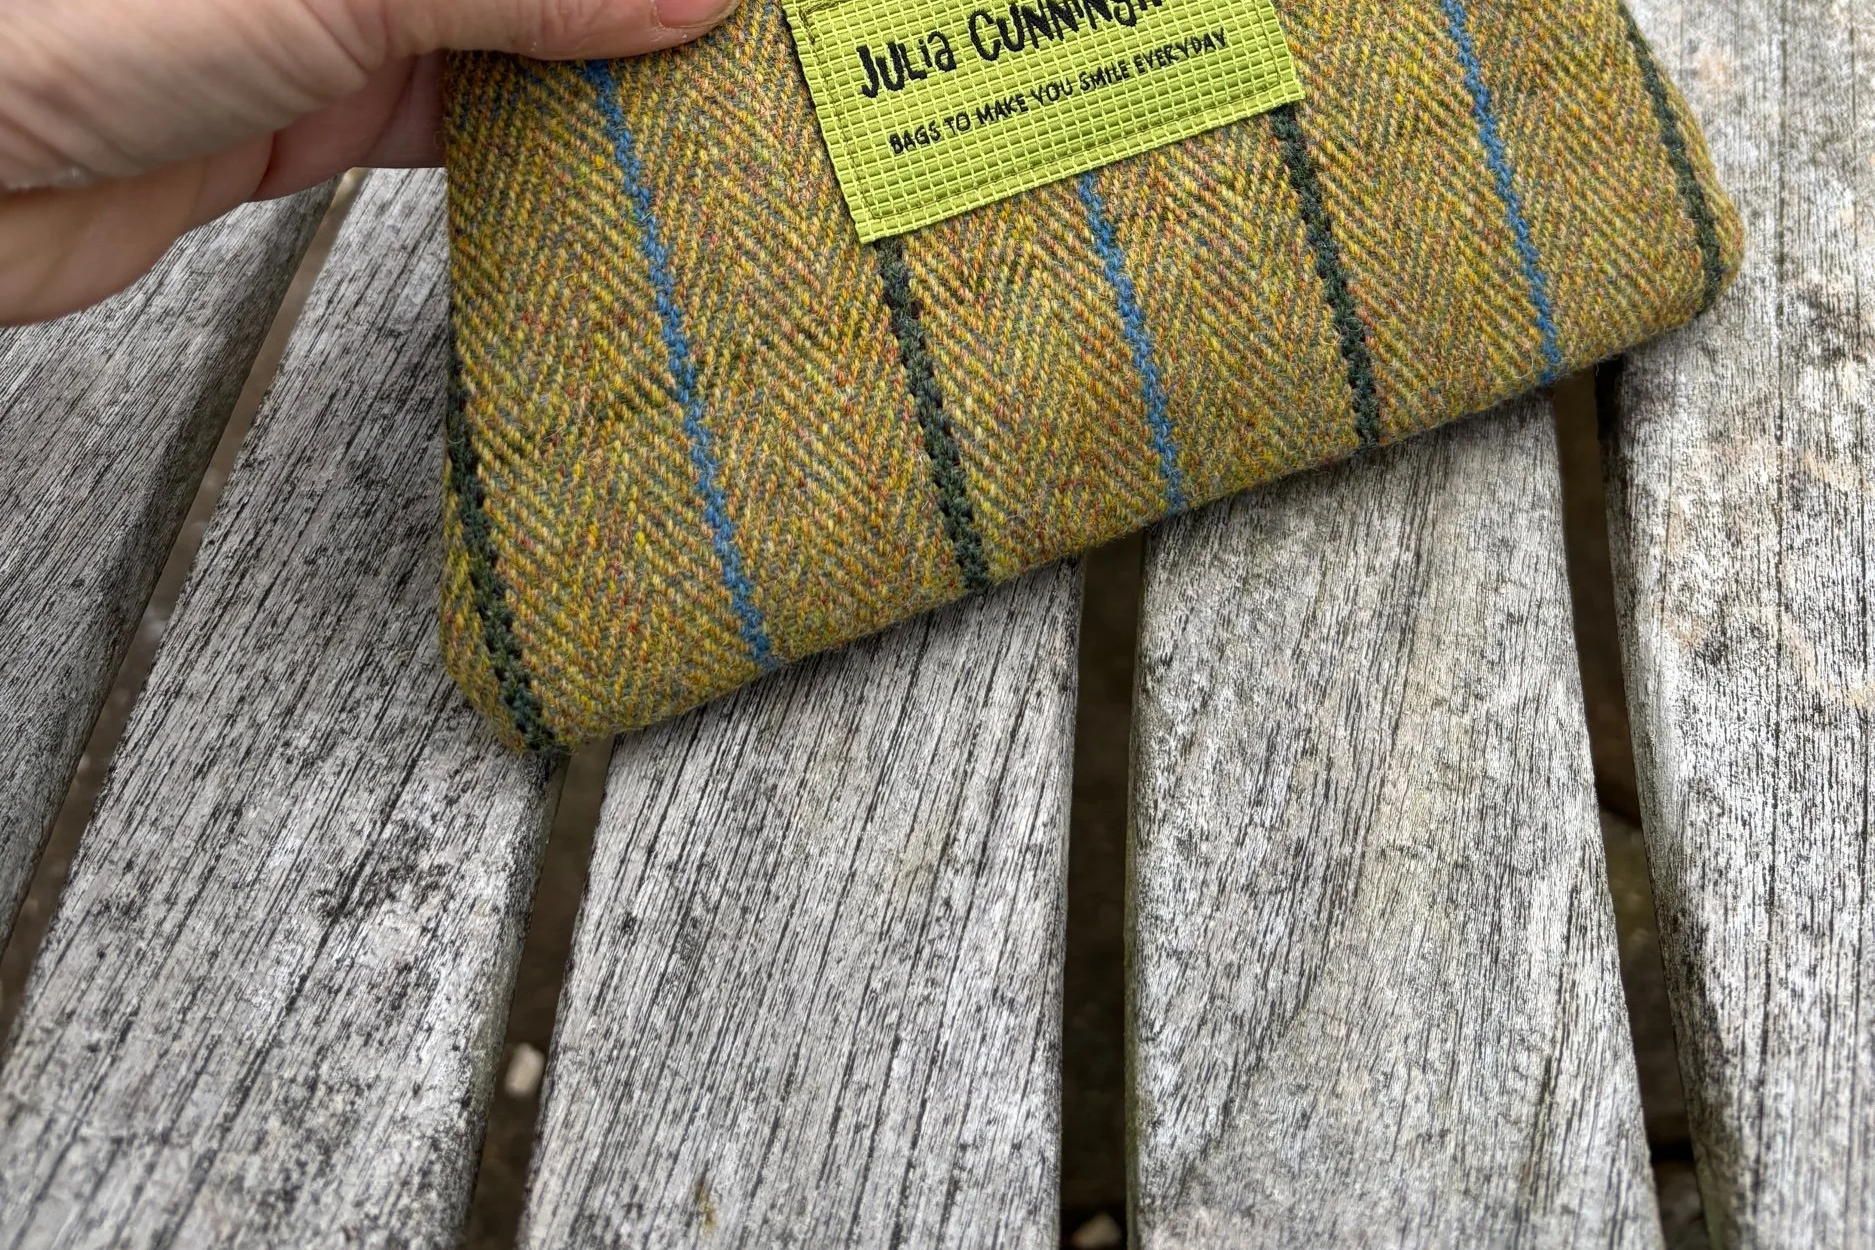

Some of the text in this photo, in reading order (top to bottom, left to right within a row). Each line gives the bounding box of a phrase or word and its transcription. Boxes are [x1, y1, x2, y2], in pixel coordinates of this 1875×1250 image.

[888, 27, 1228, 156] BAGS TO MAKE YOU SMILE EVERYDAY
